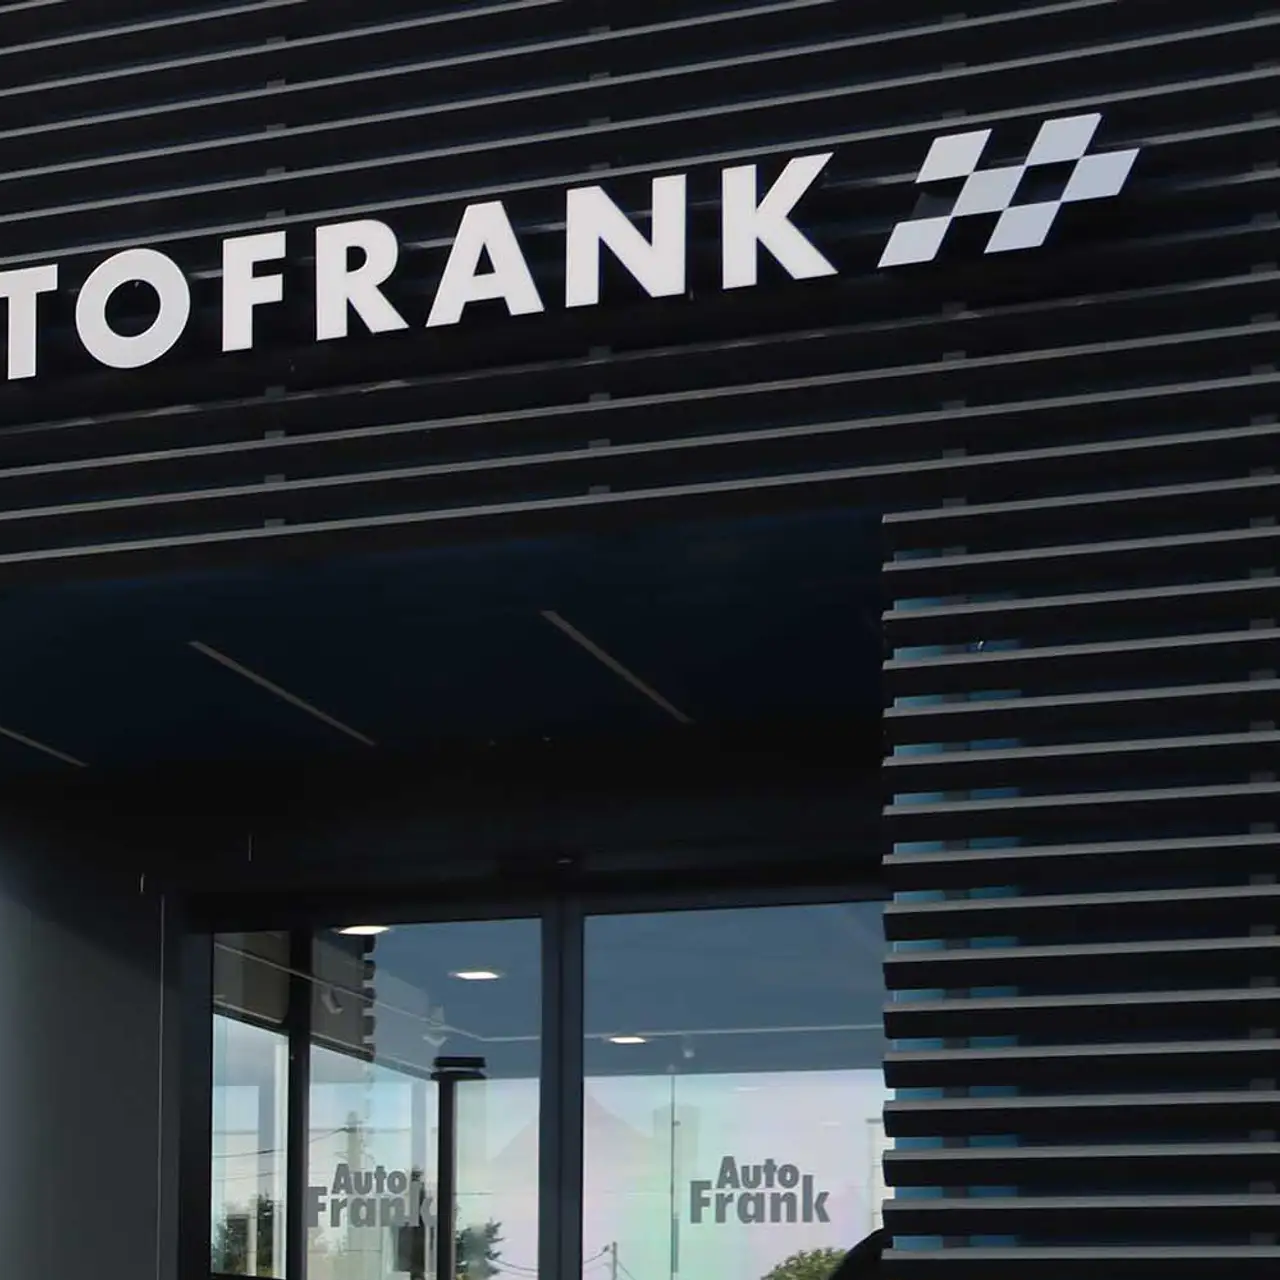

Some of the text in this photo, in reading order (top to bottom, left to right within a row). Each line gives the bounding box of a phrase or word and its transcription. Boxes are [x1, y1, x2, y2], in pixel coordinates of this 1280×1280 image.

[331, 1163, 408, 1195] Auto
[716, 1155, 800, 1189] Auto
[307, 1180, 438, 1228] Frank
[689, 1174, 831, 1224] Frank
